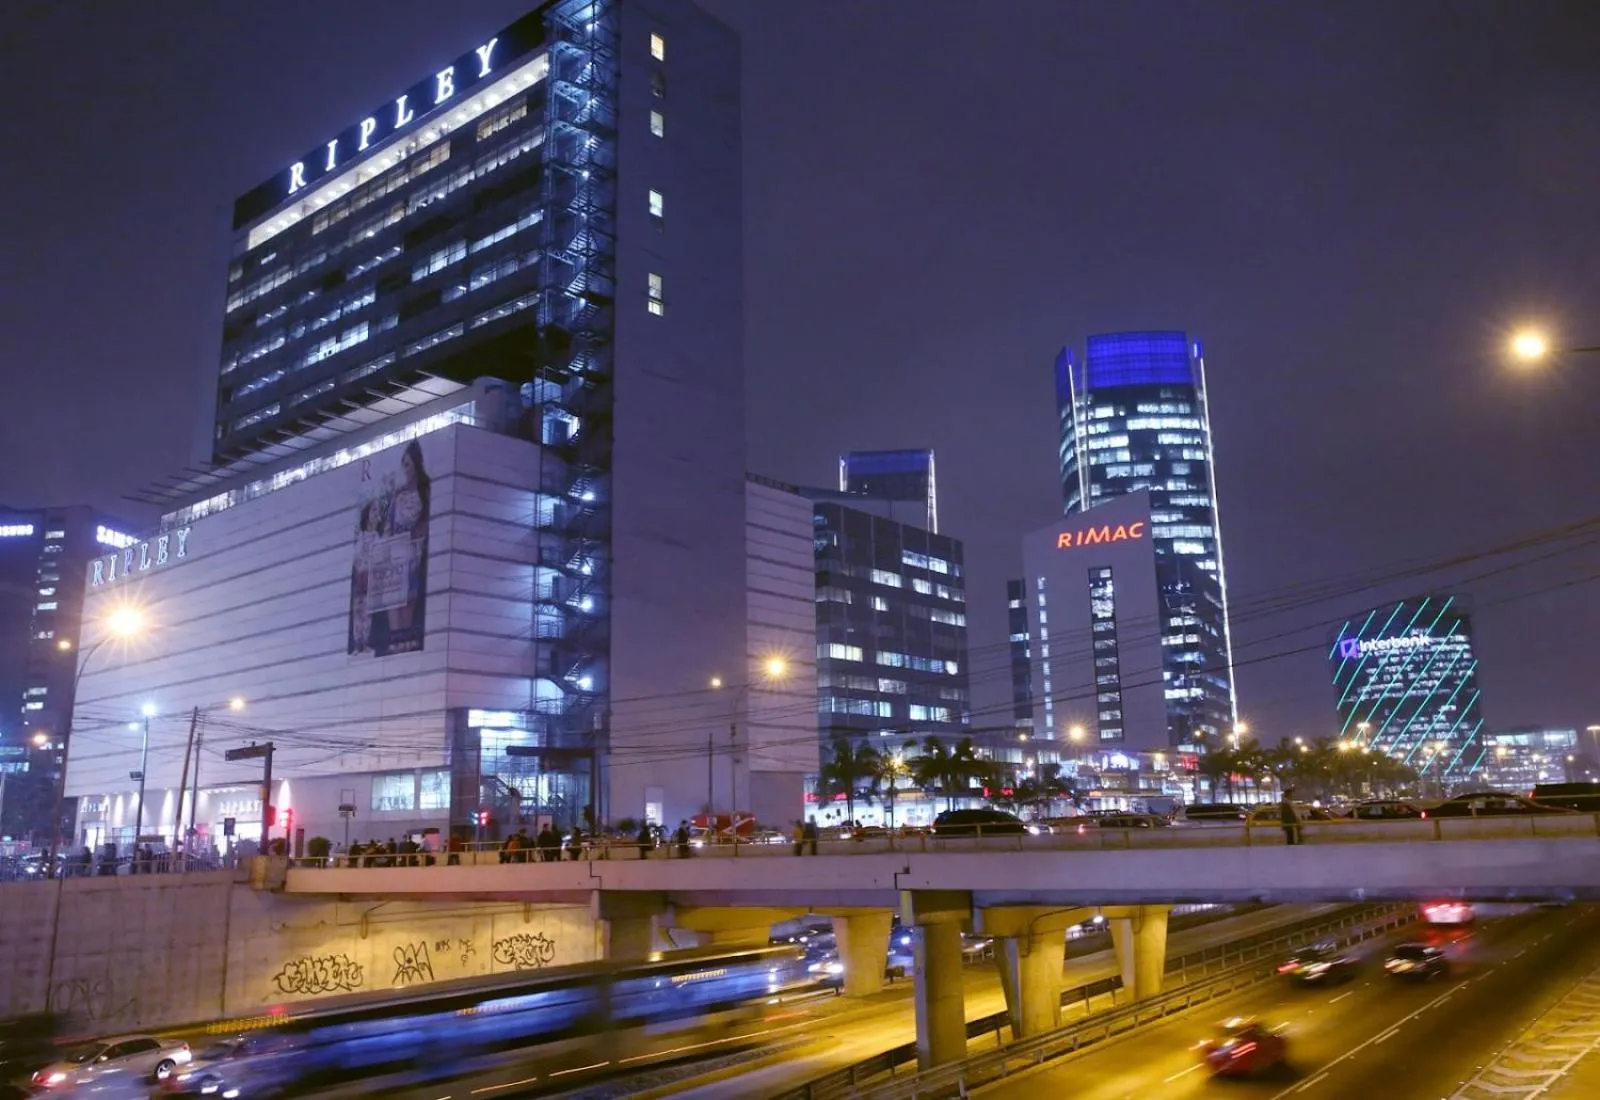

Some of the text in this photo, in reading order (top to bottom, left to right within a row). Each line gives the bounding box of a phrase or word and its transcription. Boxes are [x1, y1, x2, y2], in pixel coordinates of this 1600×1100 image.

[288, 37, 499, 195] RIPLEY
[360, 459, 372, 482] R
[1056, 521, 1145, 549] RIMAC
[92, 527, 191, 587] RIPLEY
[1359, 634, 1430, 653] Interbank
